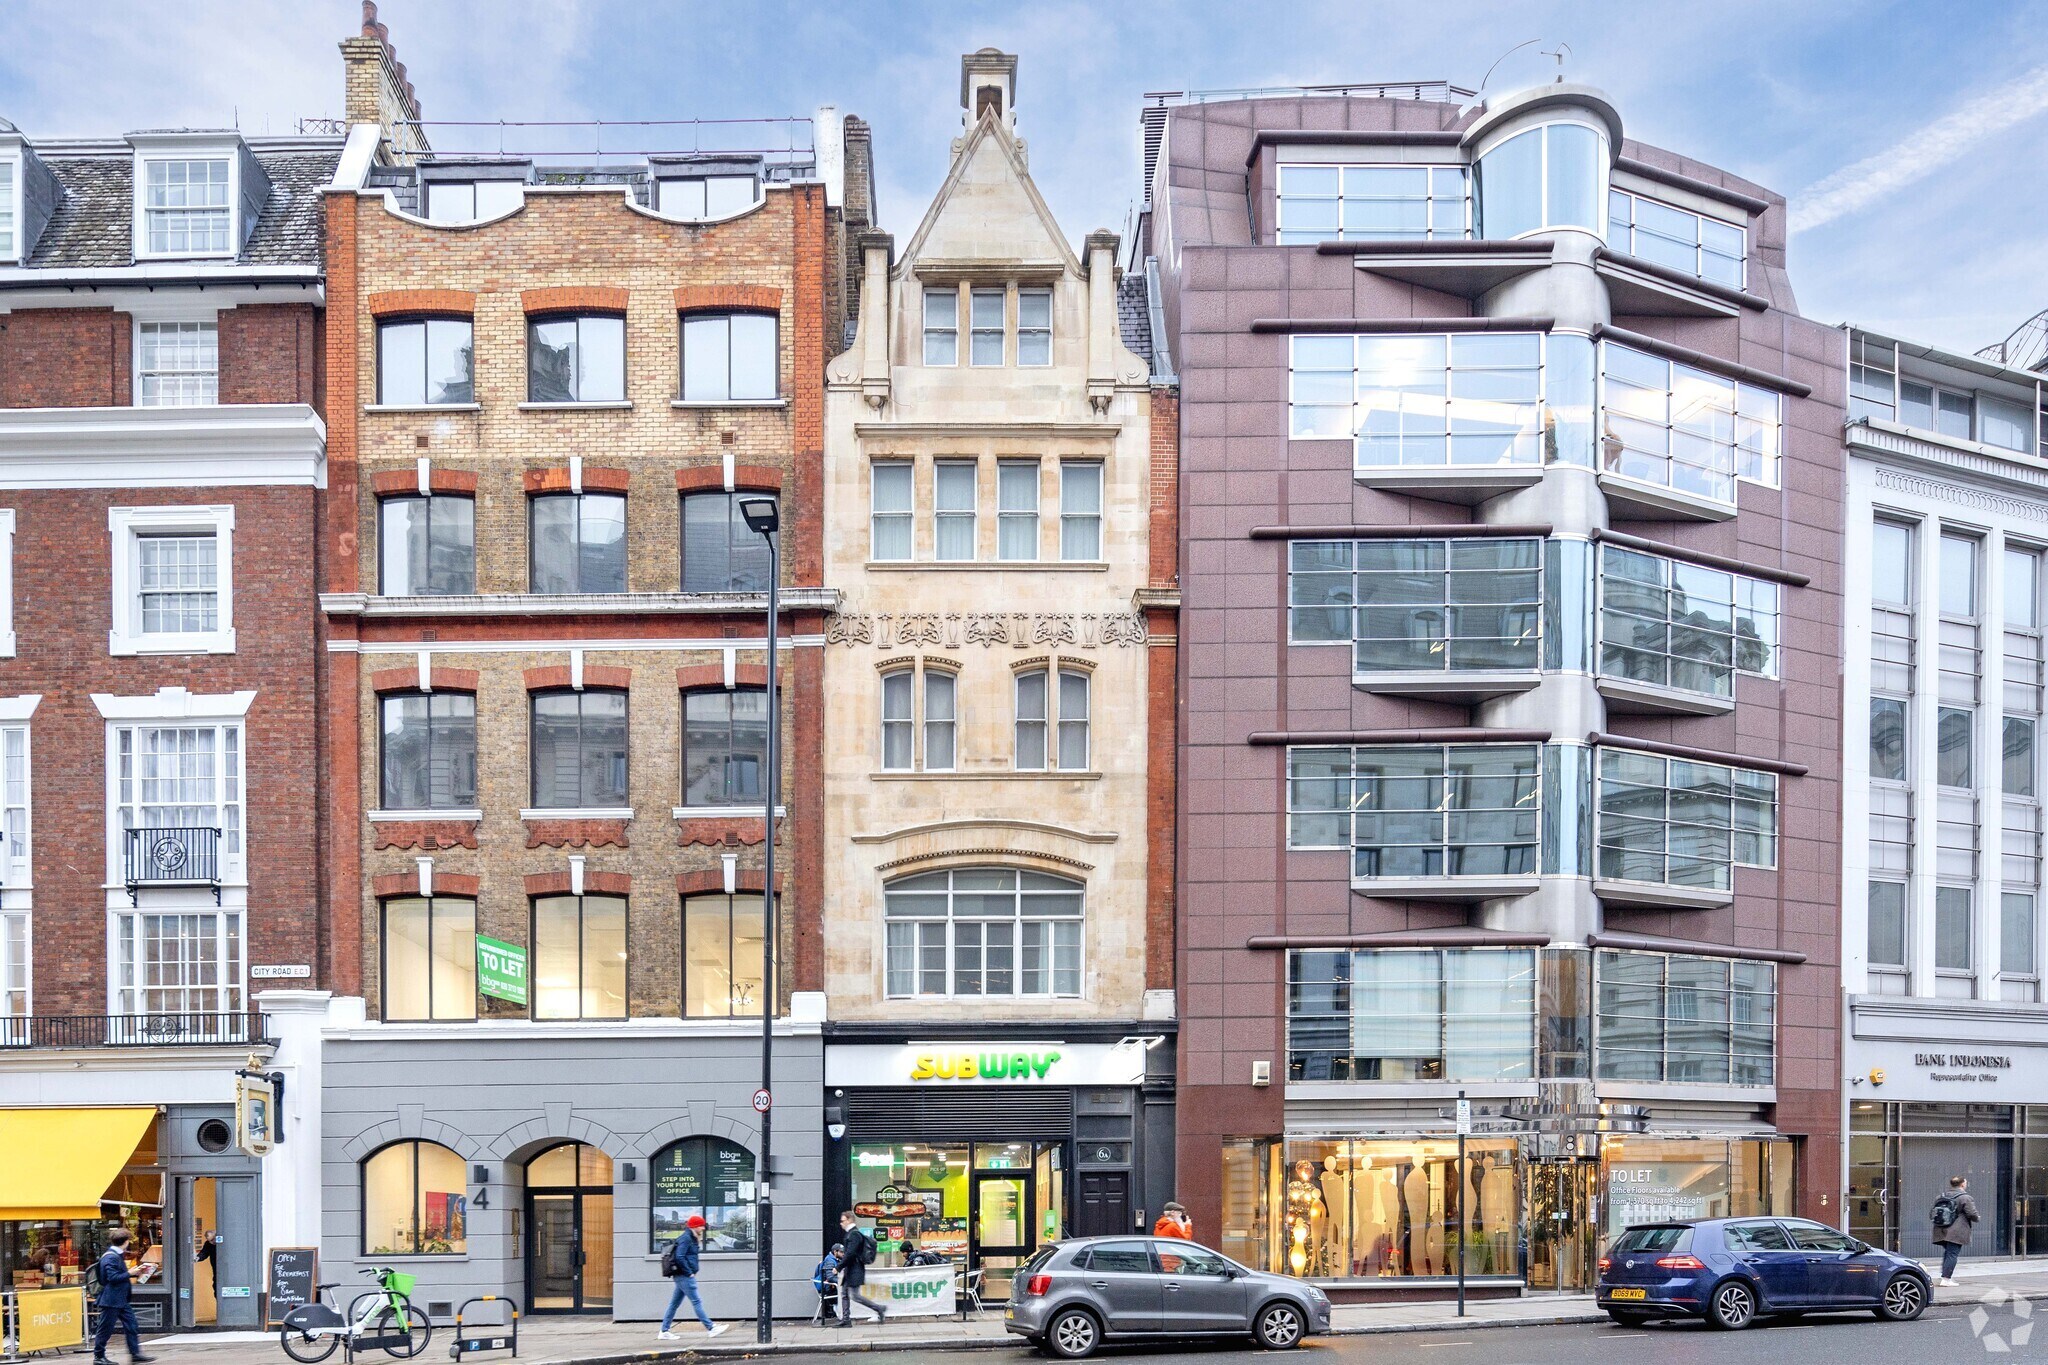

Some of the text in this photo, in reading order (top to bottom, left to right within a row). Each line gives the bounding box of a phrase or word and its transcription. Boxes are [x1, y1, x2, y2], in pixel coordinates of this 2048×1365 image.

[481, 951, 524, 978] TO LET
[254, 967, 269, 976] CITY
[272, 967, 292, 975] ROAD
[911, 1051, 1061, 1081] SUBWAY
[1915, 1053, 2012, 1069] BANK INDONESIA
[1930, 1072, 1998, 1083] Representative Office
[755, 1095, 769, 1106] 20
[720, 1150, 736, 1161] bbg
[1611, 1169, 1653, 1183] TO LET
[1610, 1186, 1681, 1194] Office Floors available
[472, 1186, 490, 1210] 4
[1645, 1198, 1653, 1206] sq
[1653, 1197, 1660, 1205] ft
[1660, 1197, 1668, 1205] to
[1669, 1196, 1687, 1206] 4,242
[1688, 1198, 1696, 1206] sq
[277, 1254, 296, 1262] OPEN
[861, 1279, 948, 1300] UBWAY
[33, 1311, 71, 1327] FINCH'S
[472, 1341, 479, 1350] P
